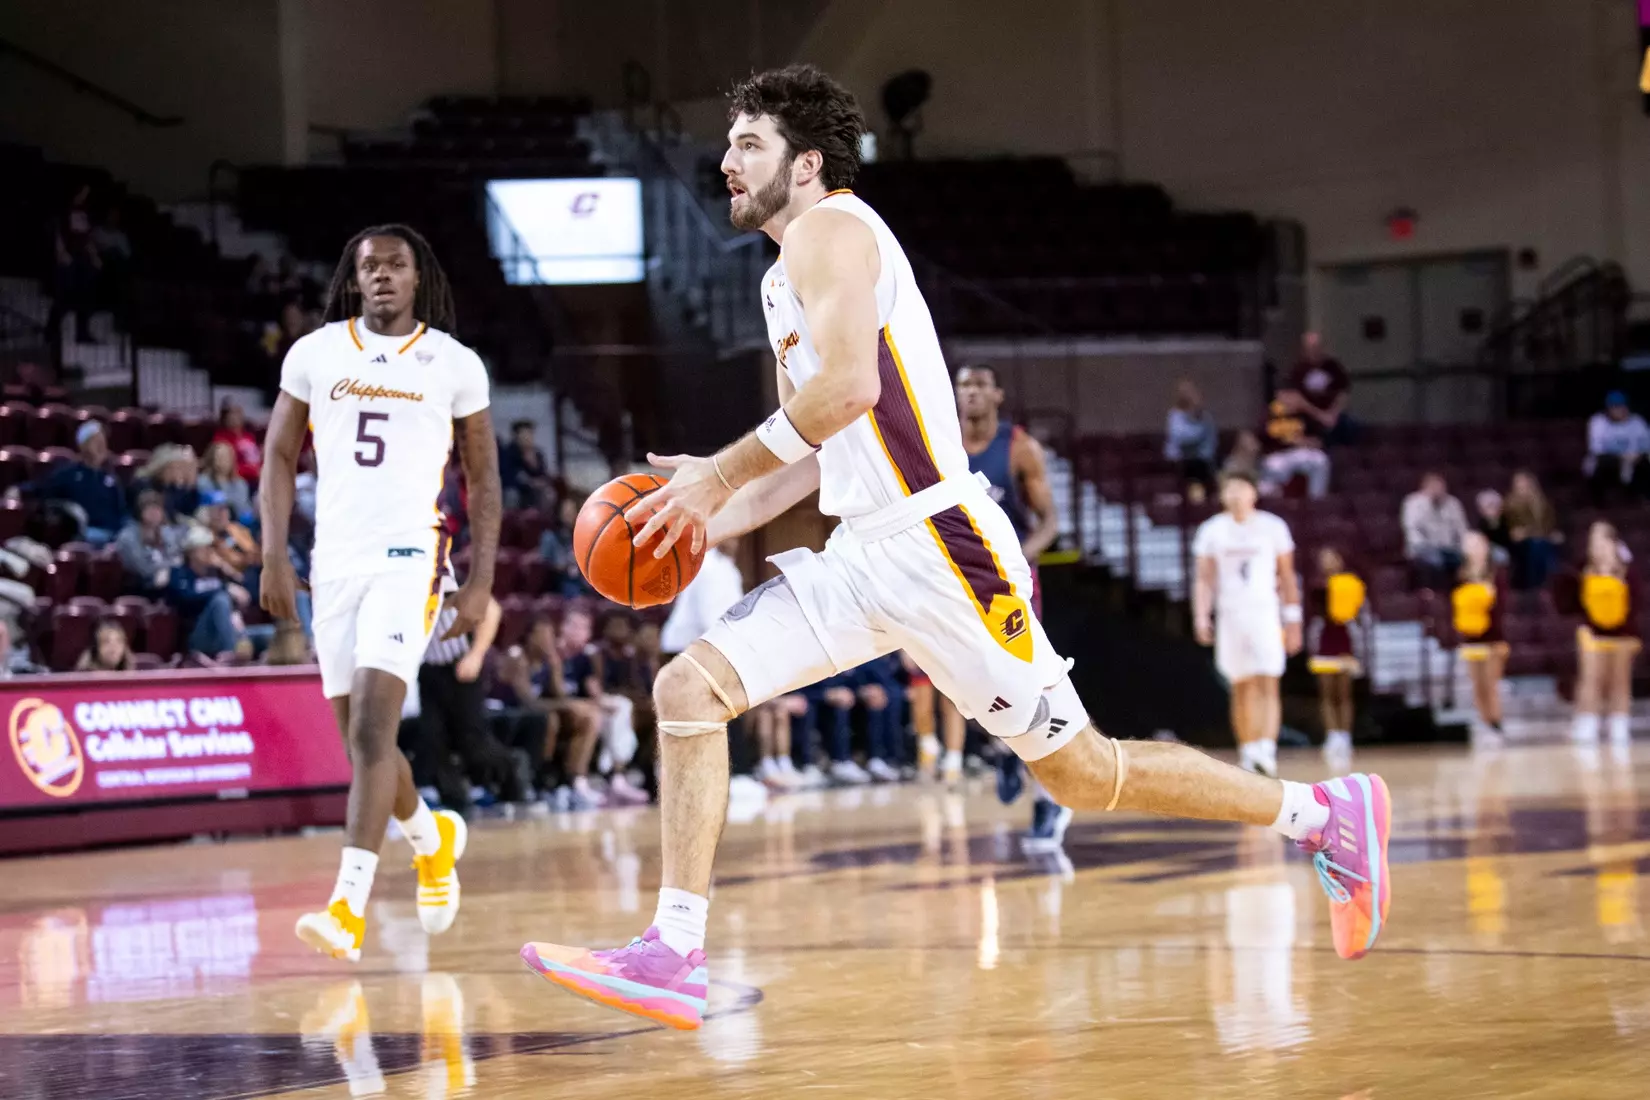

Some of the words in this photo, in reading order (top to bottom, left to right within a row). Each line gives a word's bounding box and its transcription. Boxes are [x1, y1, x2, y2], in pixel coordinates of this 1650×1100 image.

[330, 378, 423, 402] Chippewas
[354, 411, 390, 467] 5
[1004, 608, 1025, 637] C
[74, 698, 188, 731] CONNECT
[189, 696, 245, 728] CMU
[85, 729, 167, 762] Cellular
[166, 728, 255, 757] Services
